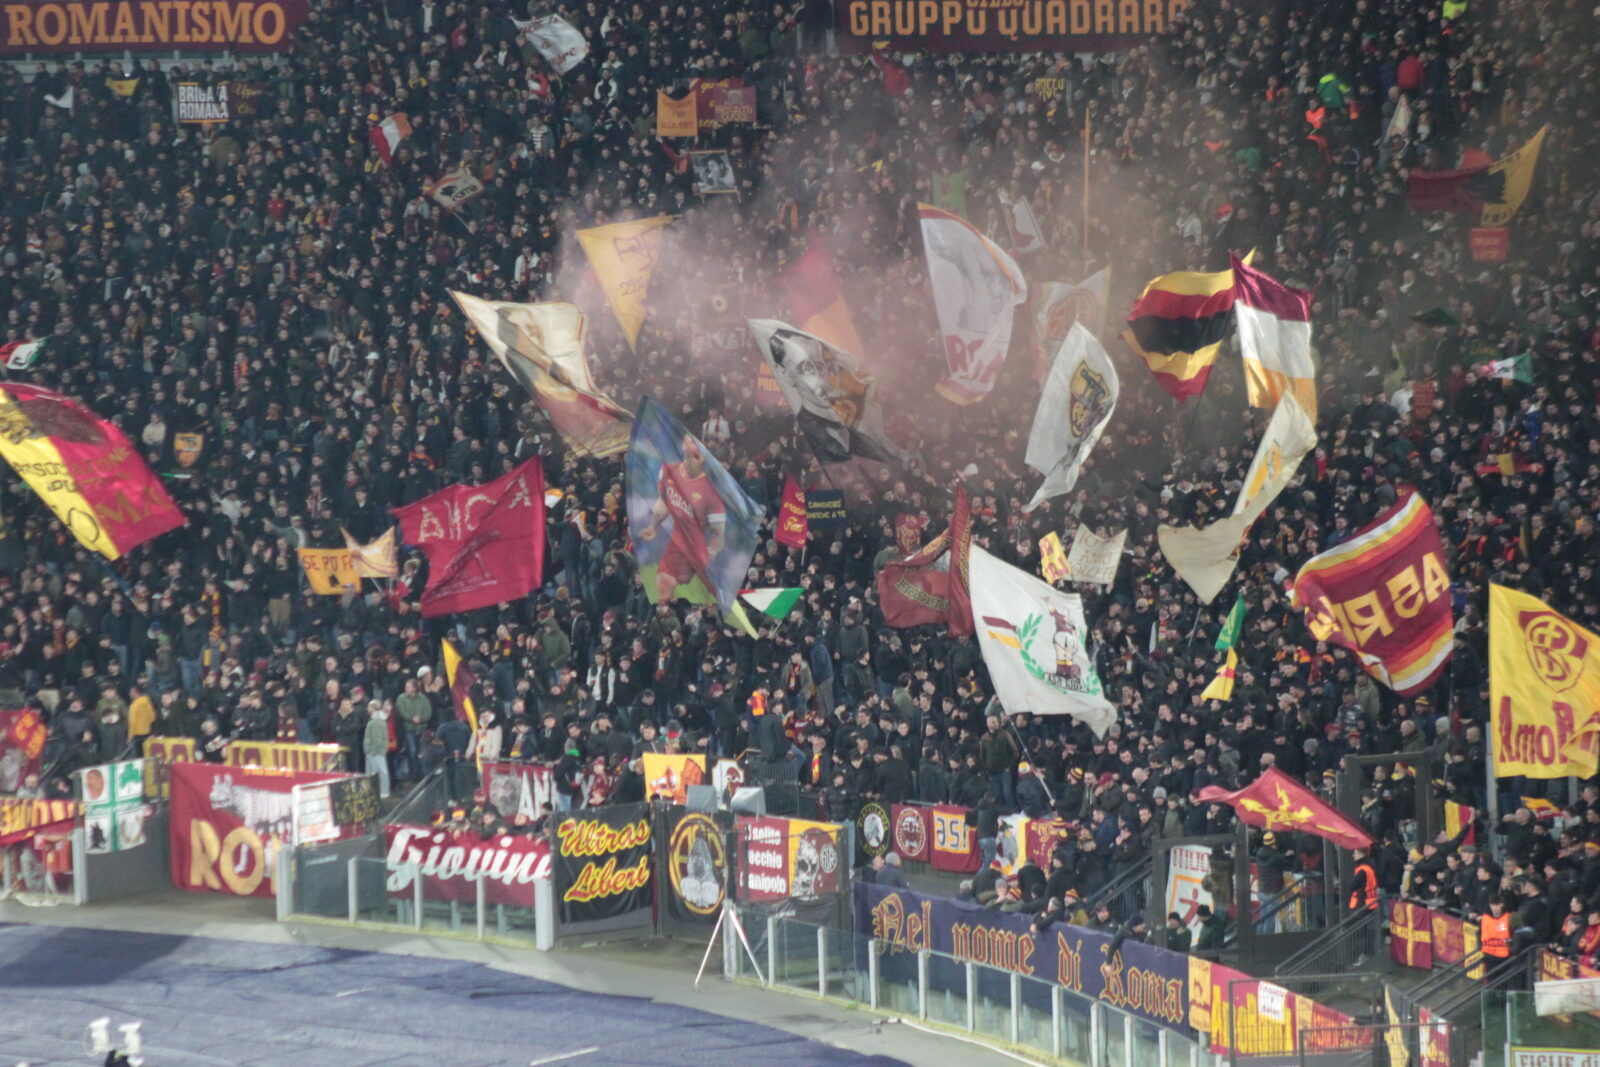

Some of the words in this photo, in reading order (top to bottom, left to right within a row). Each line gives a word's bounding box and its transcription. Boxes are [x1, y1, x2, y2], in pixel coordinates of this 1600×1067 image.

[5, 1, 287, 46] ROMANISMO
[179, 85, 229, 101] BRIGAA
[180, 102, 230, 119] ROMANA
[558, 818, 650, 857] Ultras
[753, 827, 781, 846] solito
[747, 850, 783, 869] ecchio
[563, 855, 650, 902] Liberi
[740, 872, 787, 894] anipolo
[872, 892, 932, 958] Nel
[951, 922, 1035, 976] nome
[1057, 931, 1083, 992] di
[1099, 943, 1185, 1025] Roma
[1543, 953, 1570, 980] DAJE
